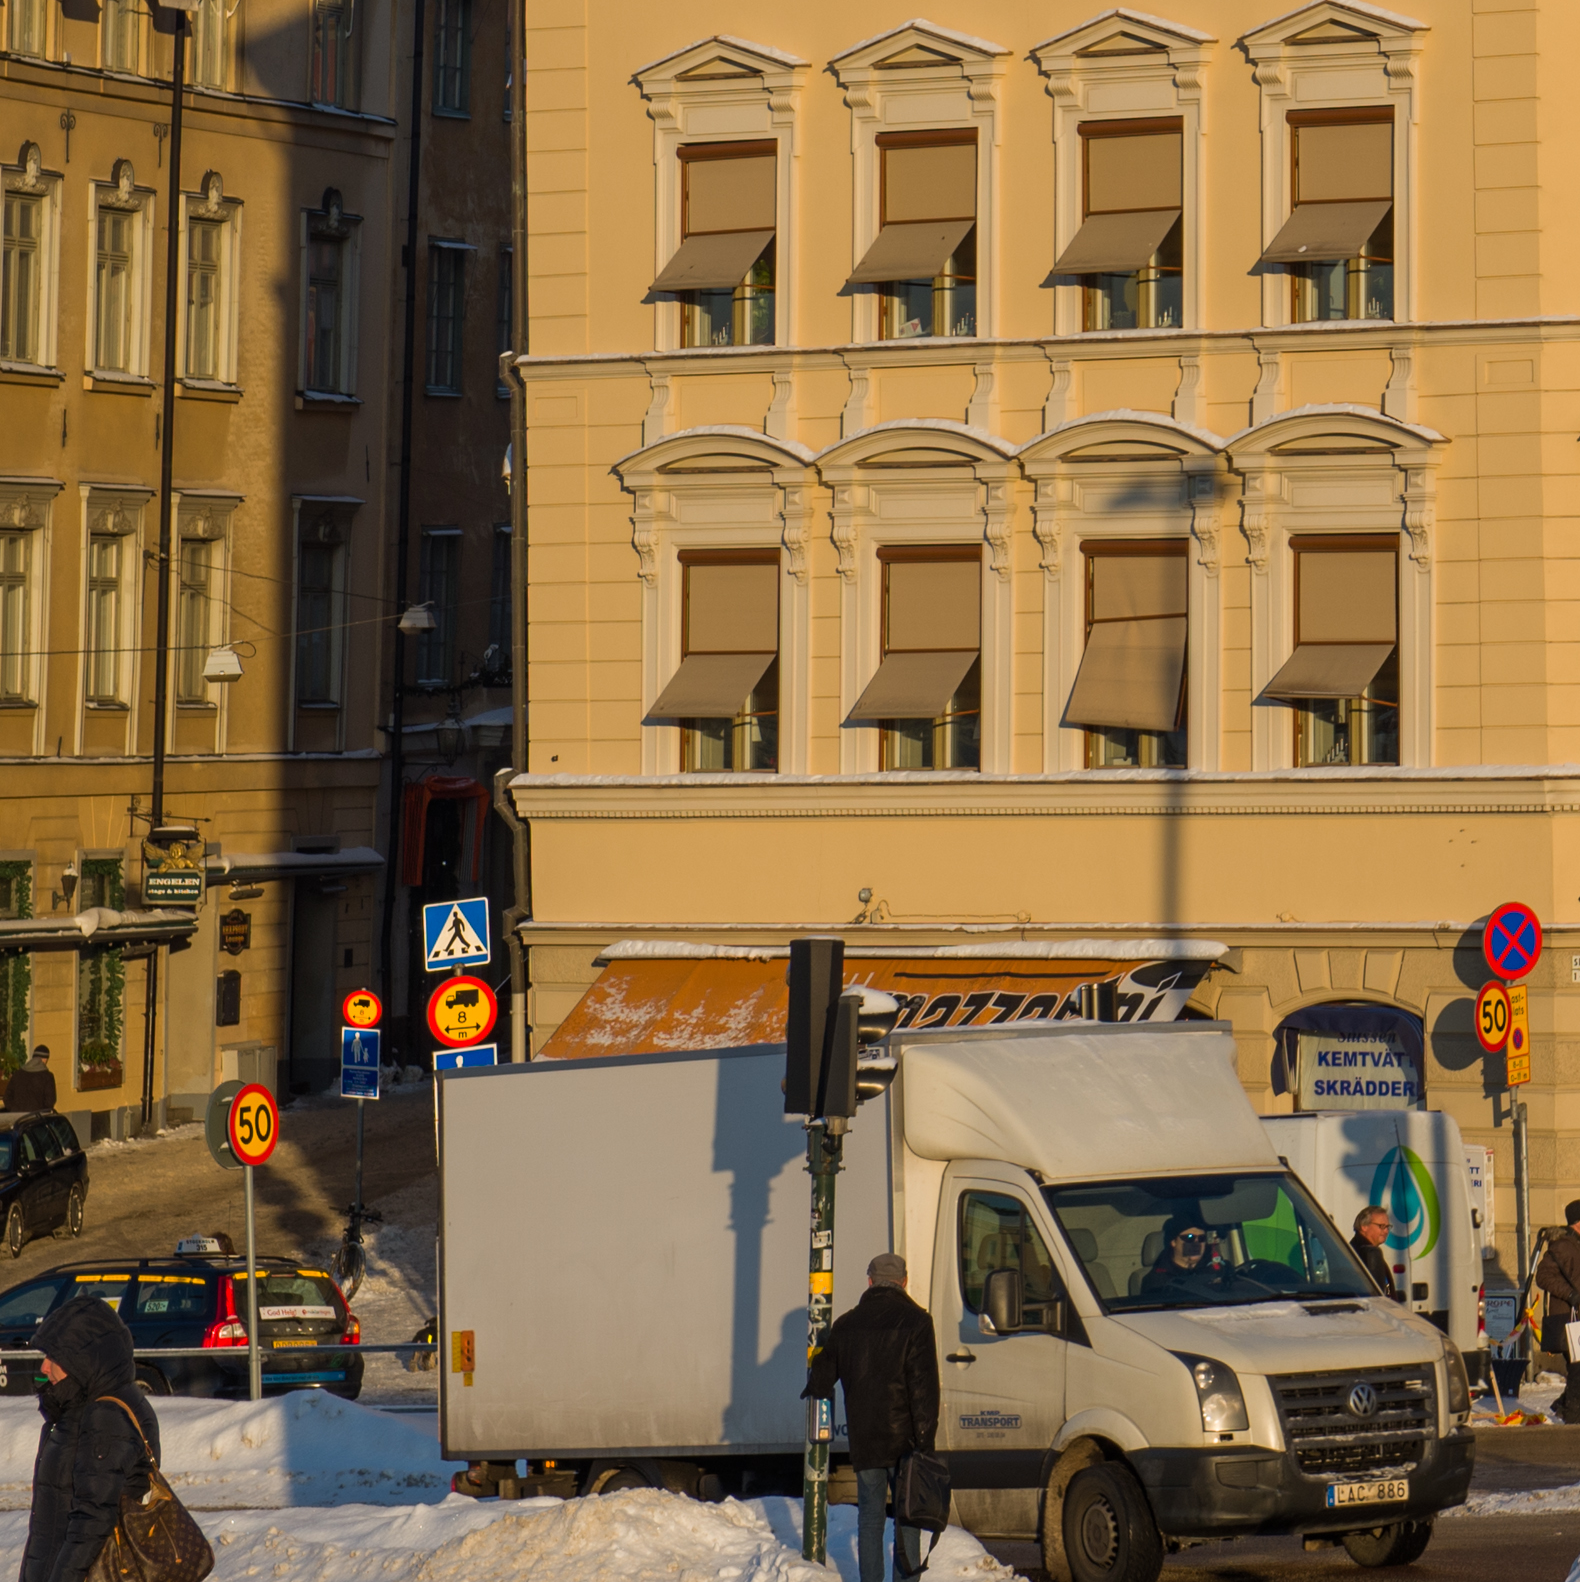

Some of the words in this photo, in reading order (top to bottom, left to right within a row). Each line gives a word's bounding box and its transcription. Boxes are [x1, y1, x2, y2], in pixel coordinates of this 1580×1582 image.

[148, 878, 200, 886] ENGELEN
[457, 1011, 467, 1024] 8
[1482, 998, 1507, 1034] 50
[458, 1030, 467, 1038] m
[238, 1105, 271, 1146] 50
[267, 1308, 280, 1316] God
[961, 1417, 1020, 1427] TRANSPORT
[1337, 1483, 1366, 1504] LAC
[1377, 1481, 1406, 1500] 886
